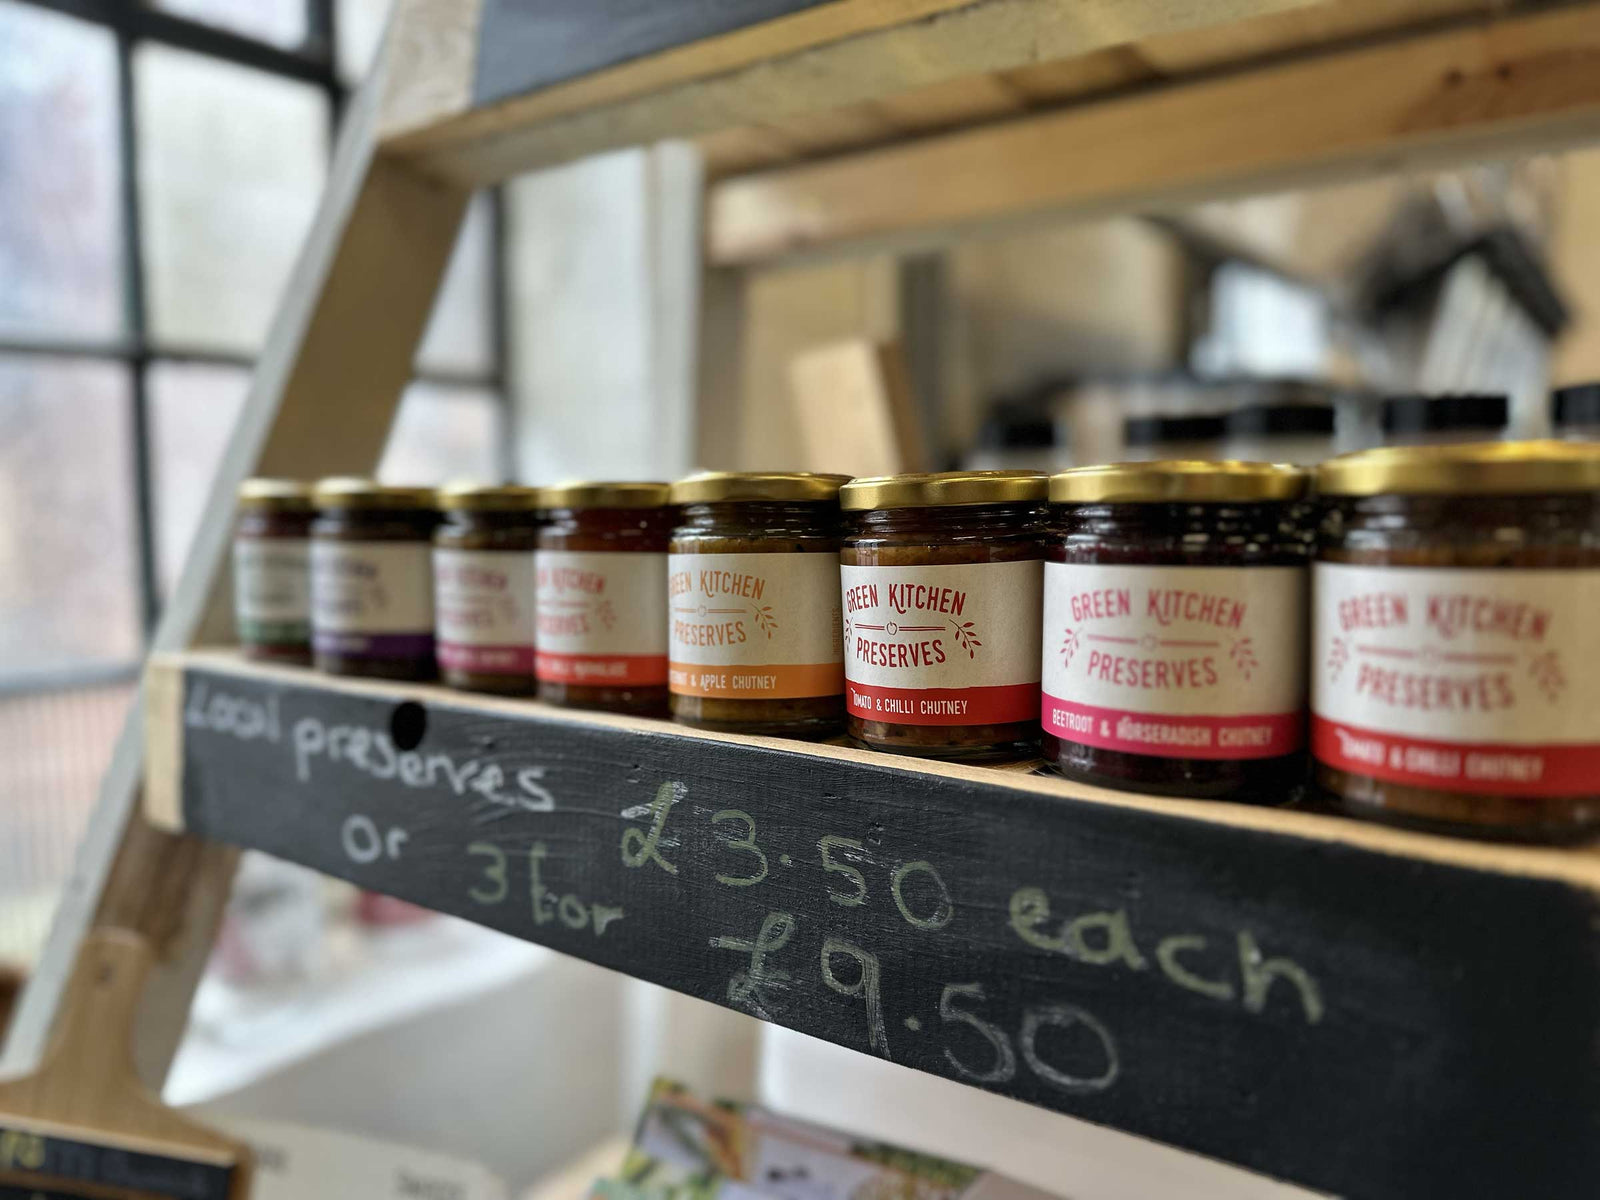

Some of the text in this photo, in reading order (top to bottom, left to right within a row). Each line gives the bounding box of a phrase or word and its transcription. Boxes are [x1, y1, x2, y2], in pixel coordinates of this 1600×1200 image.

[700, 569, 766, 601] KITCHEN
[846, 583, 967, 617] GREEN KITCHEN
[1071, 588, 1248, 630] GREEN KITCHEN
[1338, 592, 1555, 642] GREEN KITCHEN
[674, 619, 747, 647] PRESERVES
[856, 636, 946, 668] PRESERVES
[701, 674, 727, 692] APPLE
[732, 675, 777, 690] CHUTNEY
[1086, 649, 1219, 691] PRESERVES
[1356, 661, 1517, 713] PRESERVES
[850, 687, 968, 715] TOMATO & CHILLI CHUTNEY
[1052, 708, 1273, 748] BEETROOT & HORSERADISH CHUTNEY
[186, 682, 280, 743] Local
[294, 717, 555, 812] preserves
[1009, 887, 1324, 1026] each
[341, 815, 408, 864] Or
[467, 843, 508, 903] 3
[530, 841, 625, 936] for
